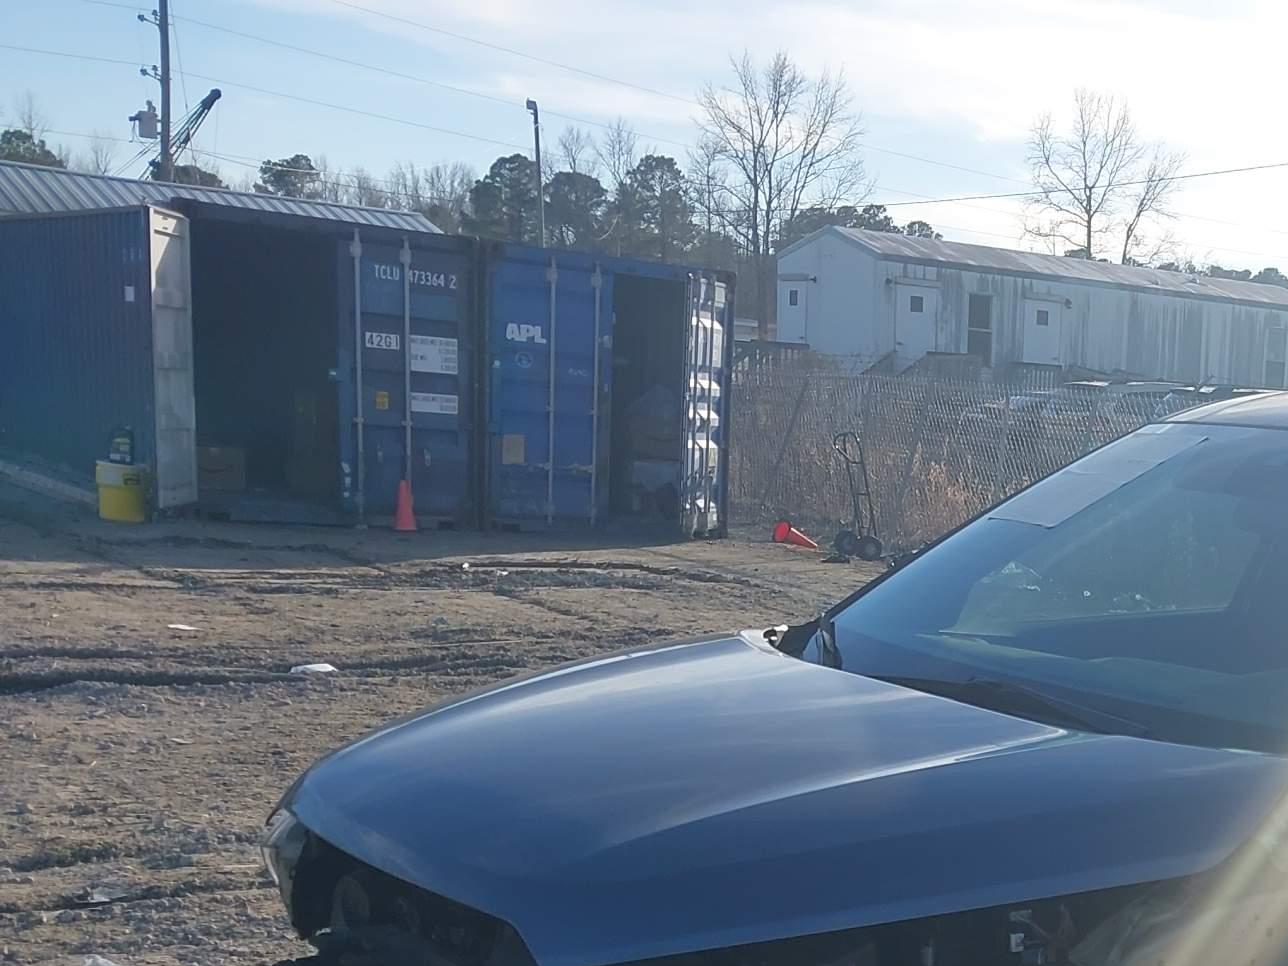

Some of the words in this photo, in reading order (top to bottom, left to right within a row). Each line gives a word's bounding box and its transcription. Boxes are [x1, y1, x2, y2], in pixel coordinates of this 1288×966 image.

[374, 264, 400, 281] TCLU
[408, 269, 445, 288] 473364
[449, 274, 457, 290] 2
[506, 322, 547, 344] APL
